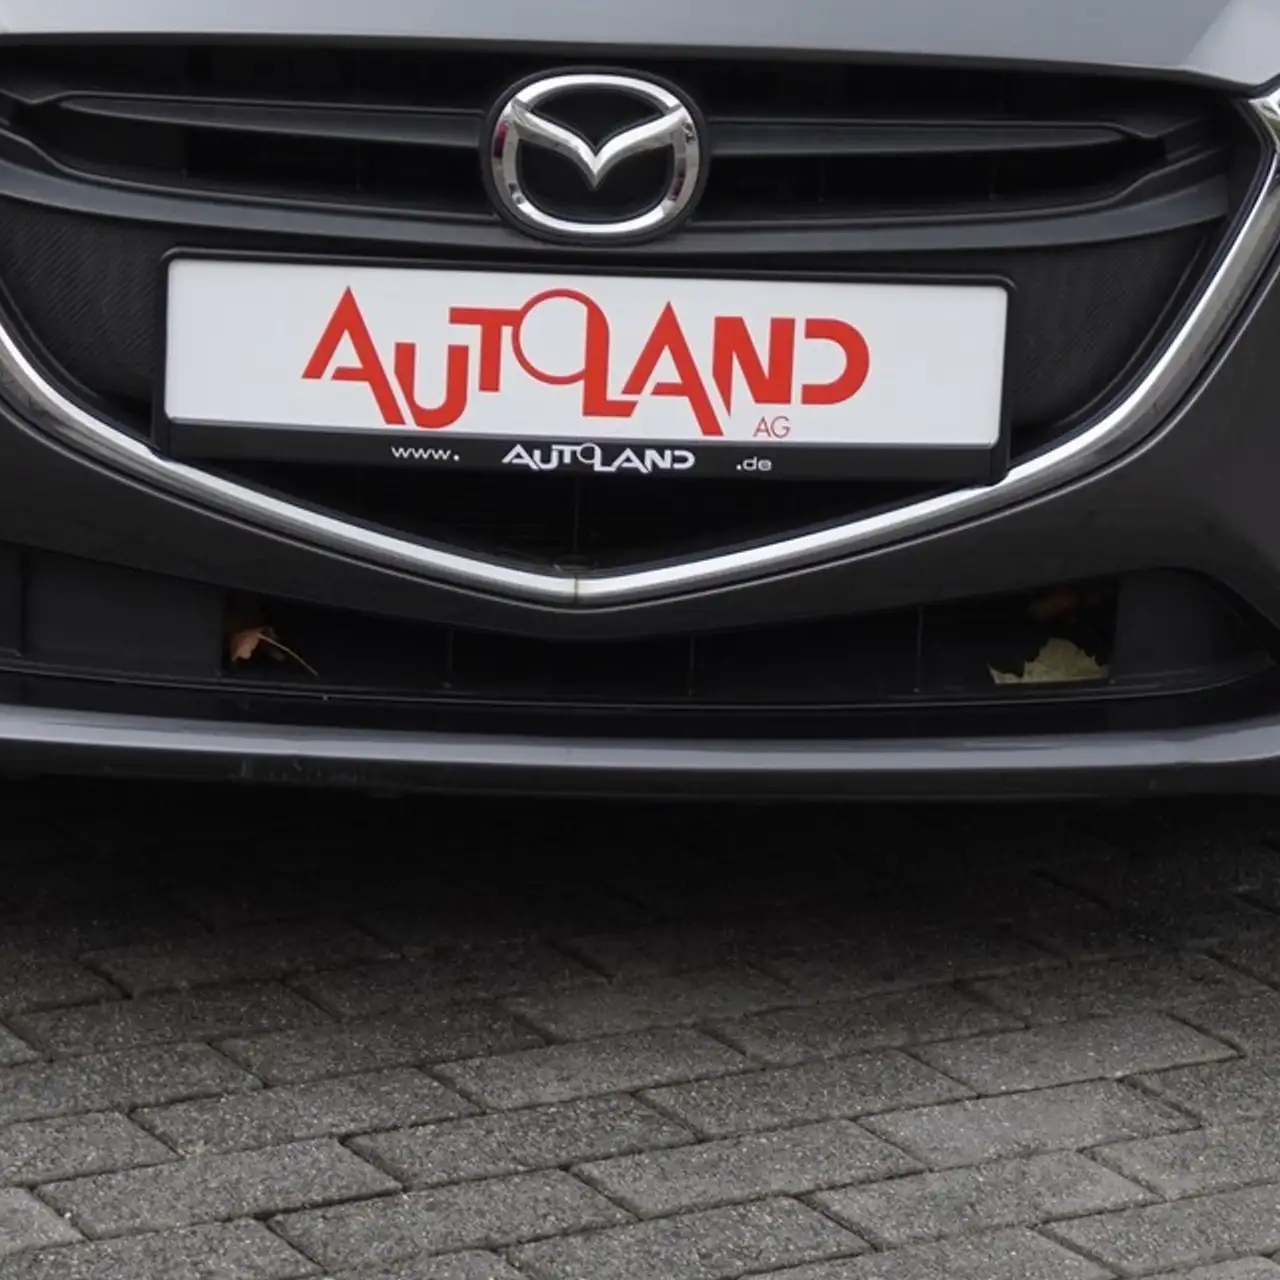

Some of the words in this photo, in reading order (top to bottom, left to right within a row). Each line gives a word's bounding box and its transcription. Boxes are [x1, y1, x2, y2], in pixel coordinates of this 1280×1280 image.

[302, 284, 871, 438] AUTOLAND
[752, 415, 792, 440] AG
[501, 441, 696, 474] AUTOLAND
[735, 455, 773, 472] .de
